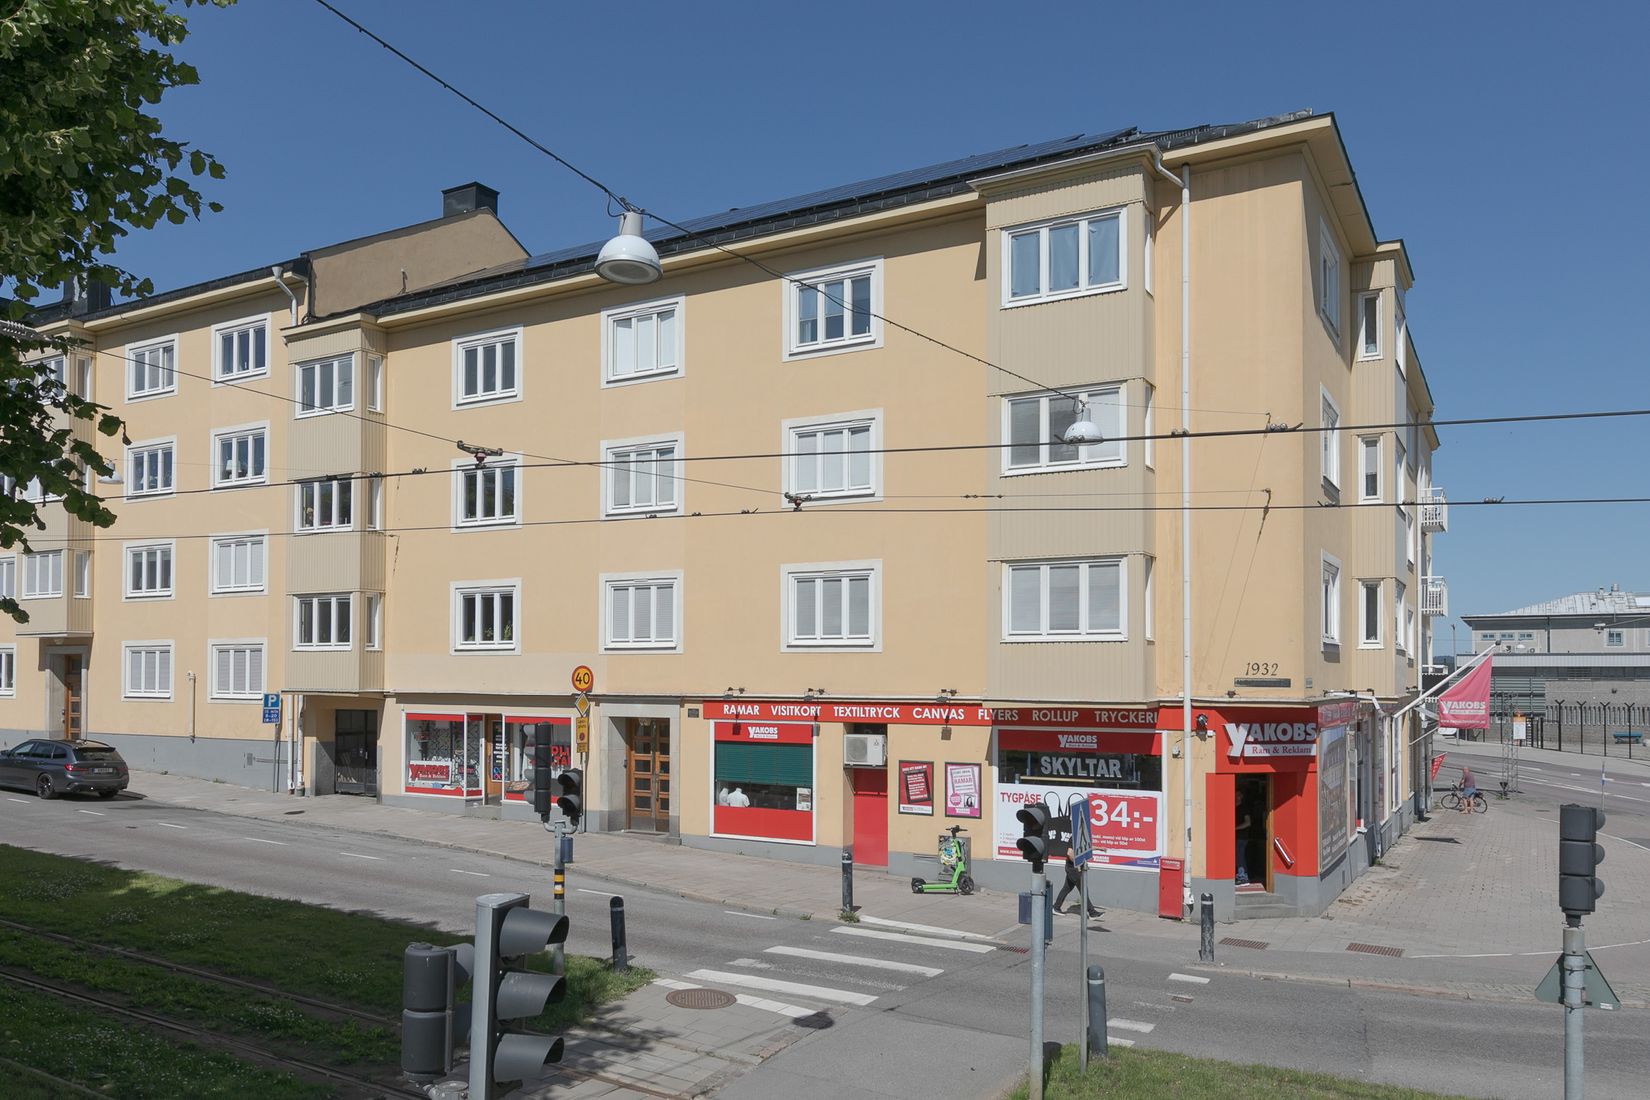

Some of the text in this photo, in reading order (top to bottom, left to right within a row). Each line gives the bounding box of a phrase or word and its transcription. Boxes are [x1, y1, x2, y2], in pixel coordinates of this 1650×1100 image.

[1245, 662, 1279, 676] 1932
[576, 672, 590, 685] 40
[268, 694, 277, 707] P
[1440, 701, 1486, 714] YAKOBS
[723, 704, 1157, 724] RAMAR VISITKORT TEXTILTRYCK CANVAS FLYERS ROLLUP TRYCKERI
[747, 726, 778, 738] YAKOBS
[1057, 734, 1097, 748] YAKOBS
[1224, 722, 1317, 757] YAKOBS
[1252, 746, 1312, 754] Ram & Reklam
[1040, 755, 1122, 778] SKYLTAR
[1000, 791, 1042, 805] TYGPÅSE
[1091, 799, 1153, 829] 34:-
